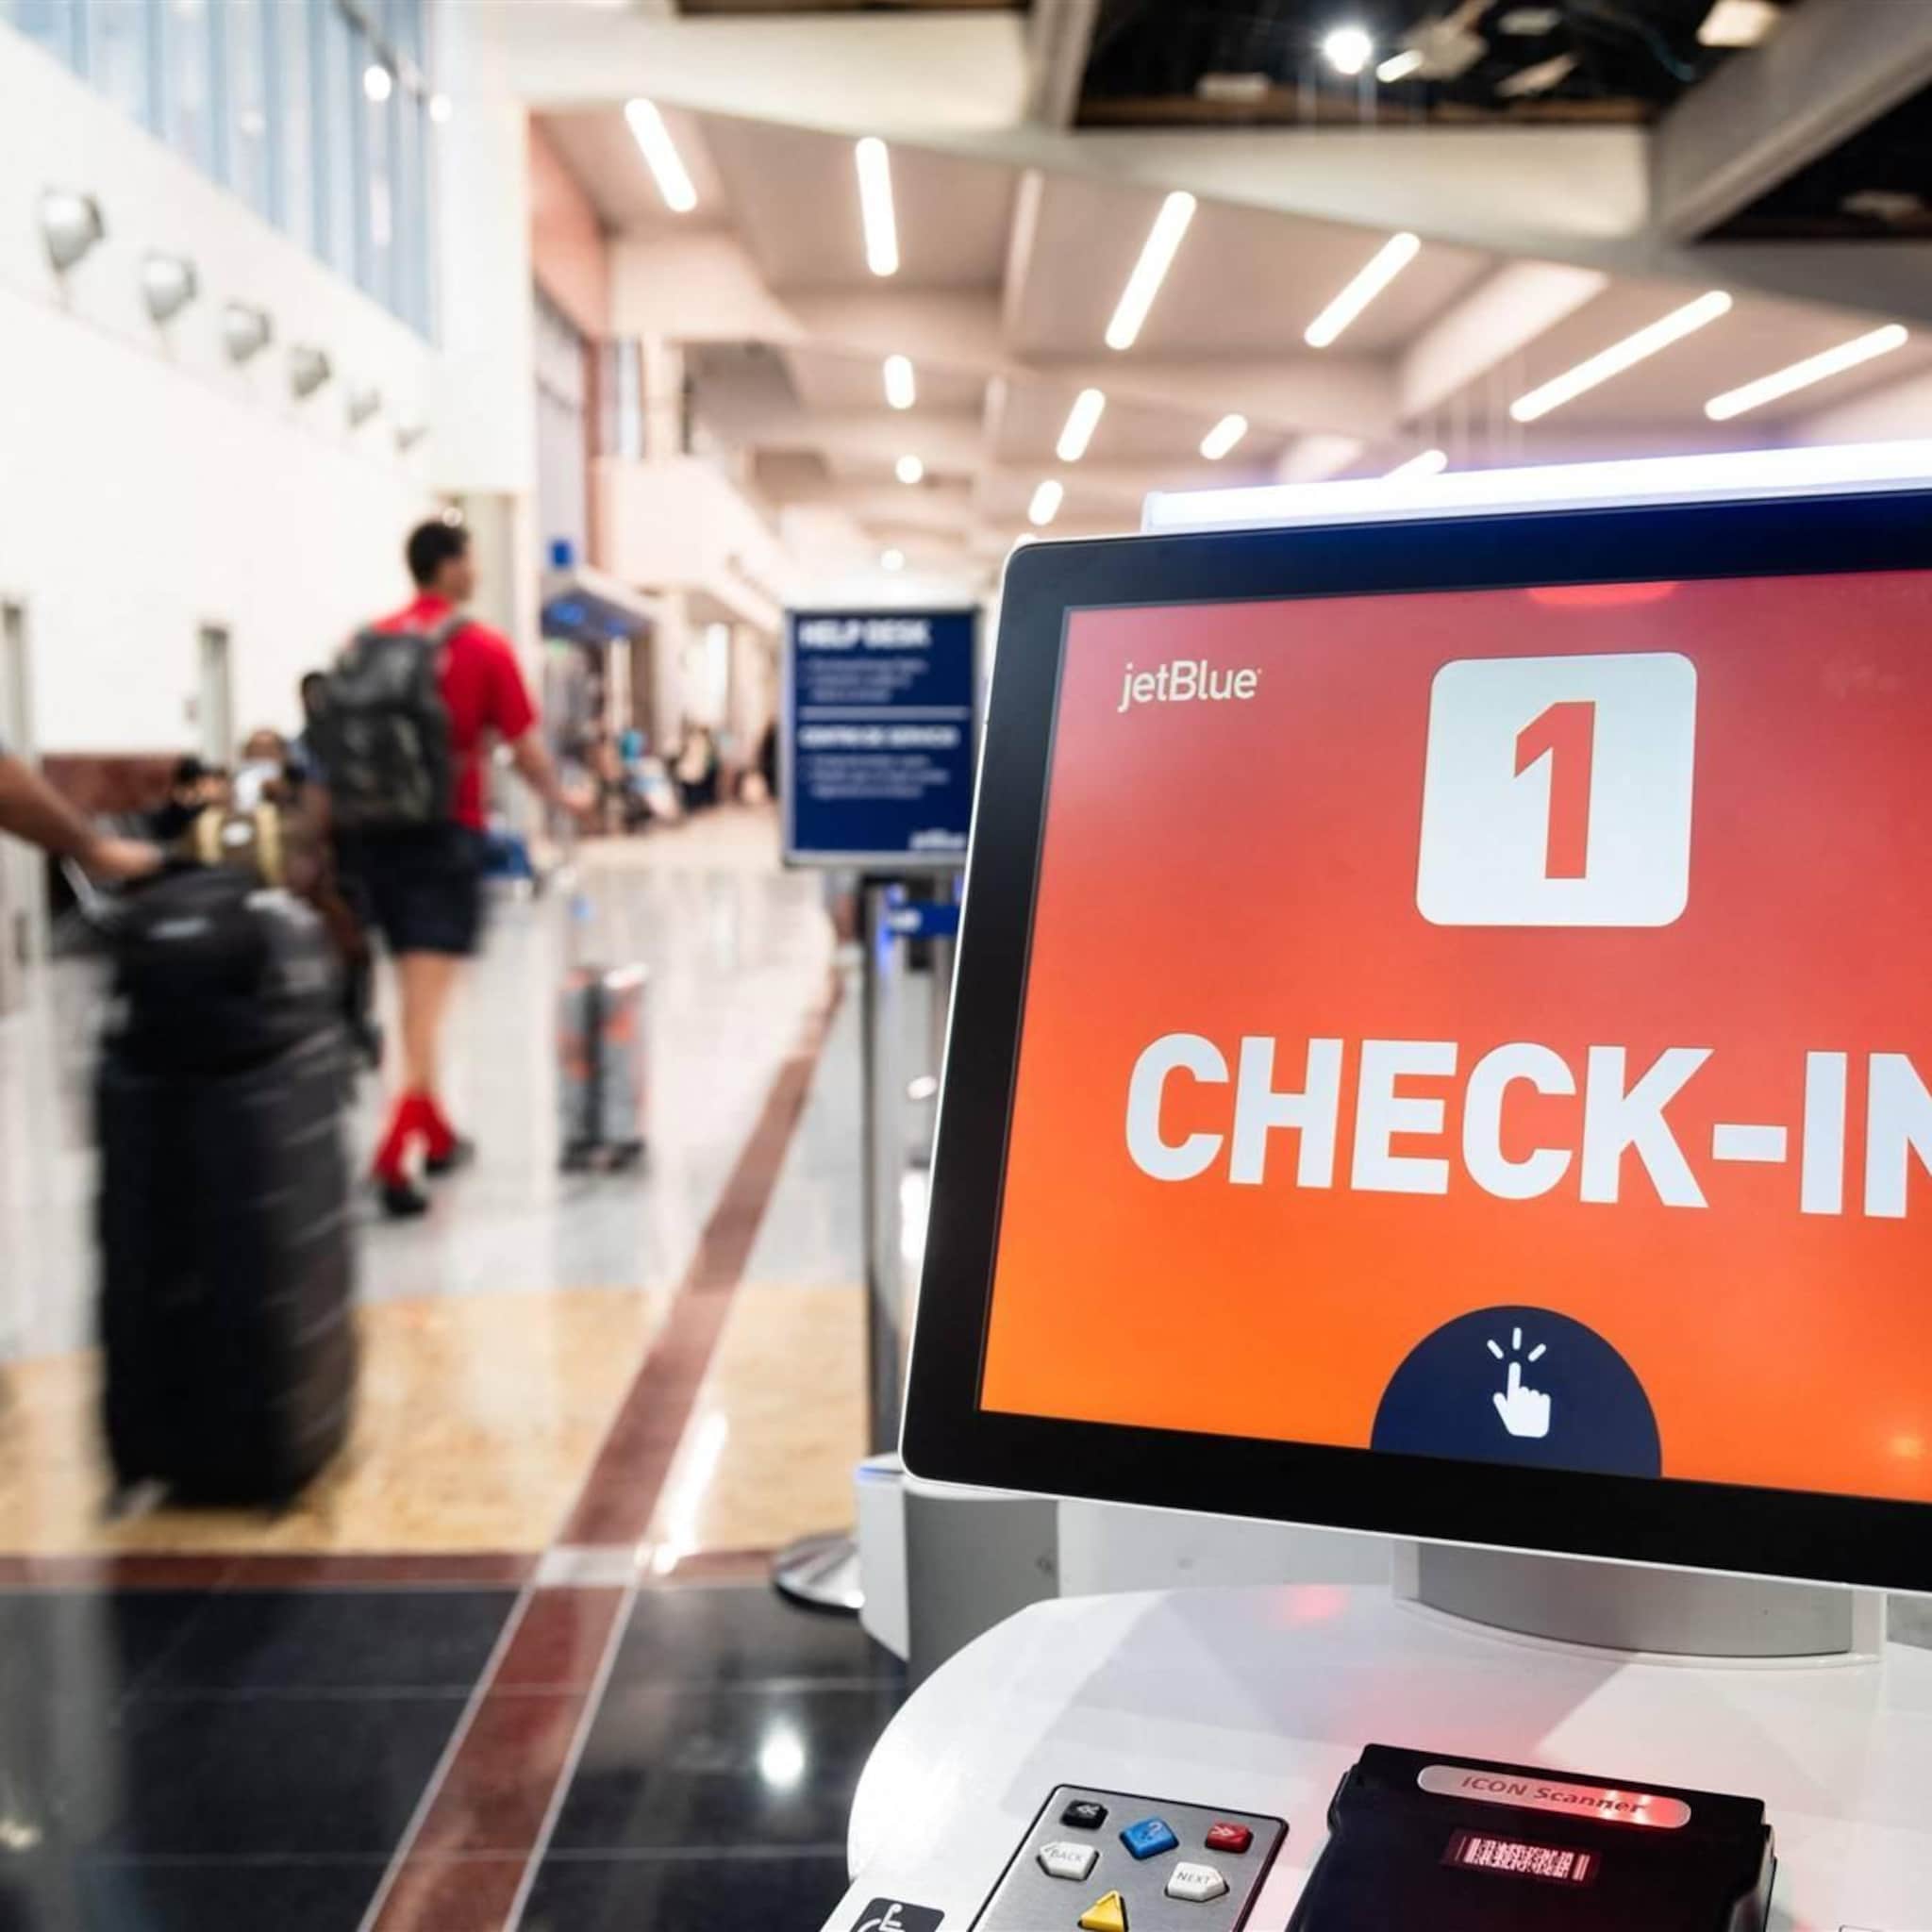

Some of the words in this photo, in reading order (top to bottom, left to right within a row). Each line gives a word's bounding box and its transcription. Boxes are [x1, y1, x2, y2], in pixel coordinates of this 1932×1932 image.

[1117, 659, 1257, 712] jetBlue
[1514, 700, 1596, 879] 1
[1462, 1775, 1527, 1796] ICON
[1534, 1787, 1645, 1813] Scanner
[1049, 1849, 1084, 1862] BACK
[1176, 1871, 1210, 1885] NEXT
